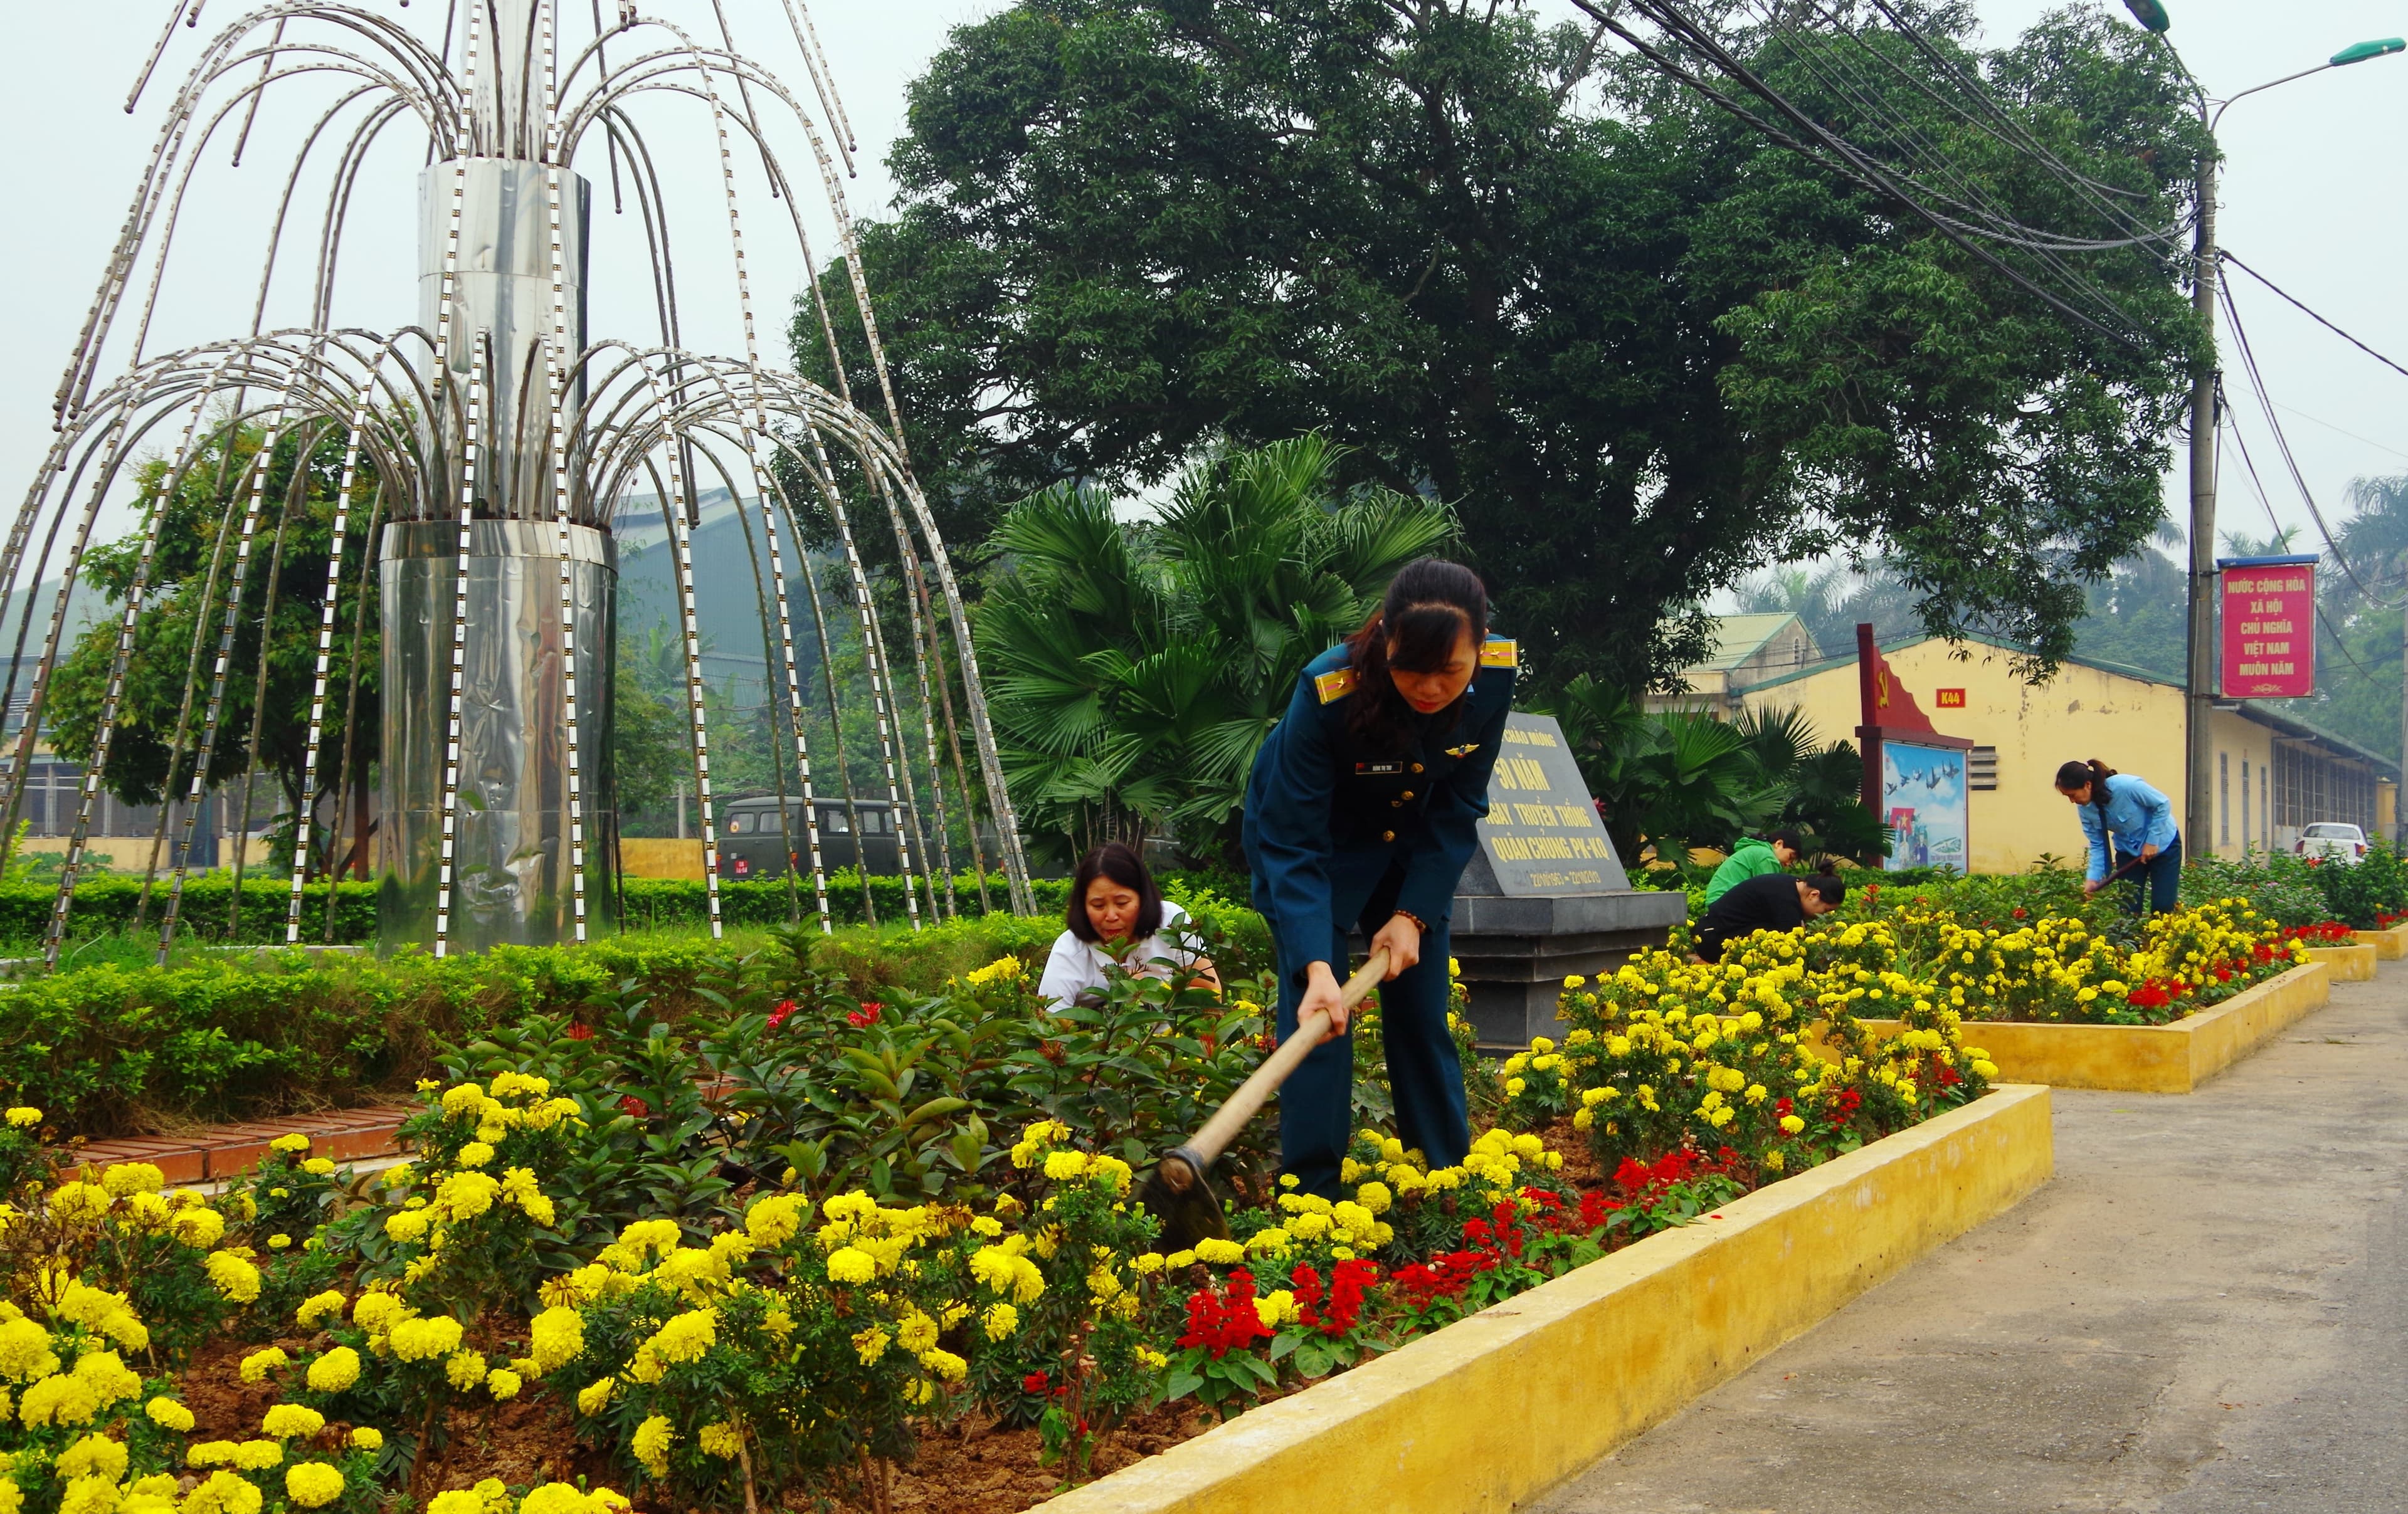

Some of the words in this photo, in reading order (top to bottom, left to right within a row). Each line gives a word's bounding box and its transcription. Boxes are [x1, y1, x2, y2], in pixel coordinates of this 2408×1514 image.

[2228, 577, 2254, 594] NƯỚC
[2257, 577, 2283, 595] CỘNG
[2286, 576, 2306, 591] HÒA
[2250, 599, 2264, 614] XÃ
[2266, 598, 2283, 616] HỘI
[2241, 617, 2260, 634] CHỦ
[2263, 619, 2293, 634] NGHĨA
[2244, 640, 2264, 657] VIỆT
[2266, 642, 2289, 654] NAM
[2239, 661, 2268, 676] MUÔN
[1941, 692, 1960, 704] K44
[1503, 725, 1529, 745] CHÀO
[1509, 752, 1551, 791] NĂM
[1491, 831, 1533, 863] QUÂN
[1526, 828, 1573, 860] CHỦNG
[1569, 837, 1610, 861] PK-KQ
